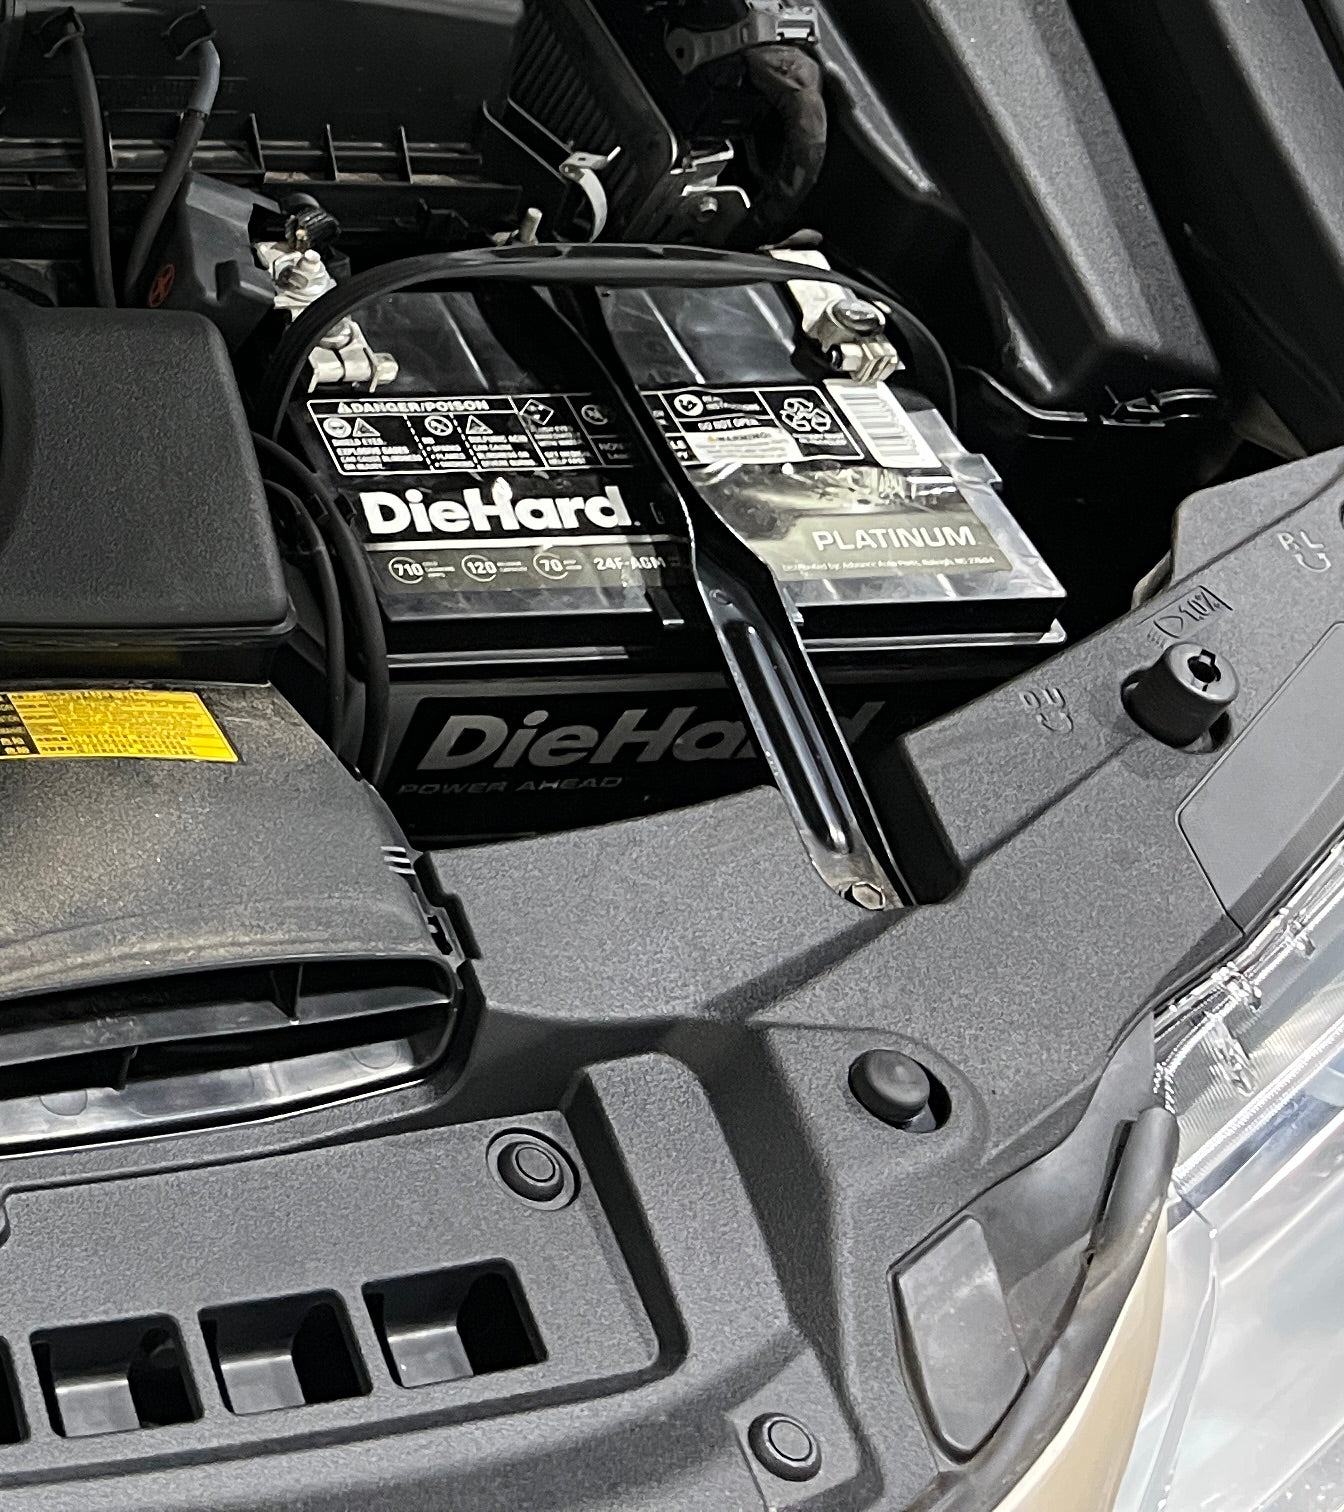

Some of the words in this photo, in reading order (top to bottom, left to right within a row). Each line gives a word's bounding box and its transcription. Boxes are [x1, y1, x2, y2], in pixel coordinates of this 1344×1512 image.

[359, 485, 633, 534] DieHard
[812, 526, 977, 551] PLATINUM
[392, 561, 424, 577] 710
[466, 560, 497, 575] 120
[539, 558, 563, 573] 70
[398, 781, 508, 794] POWER
[515, 776, 623, 792] AHEAD
